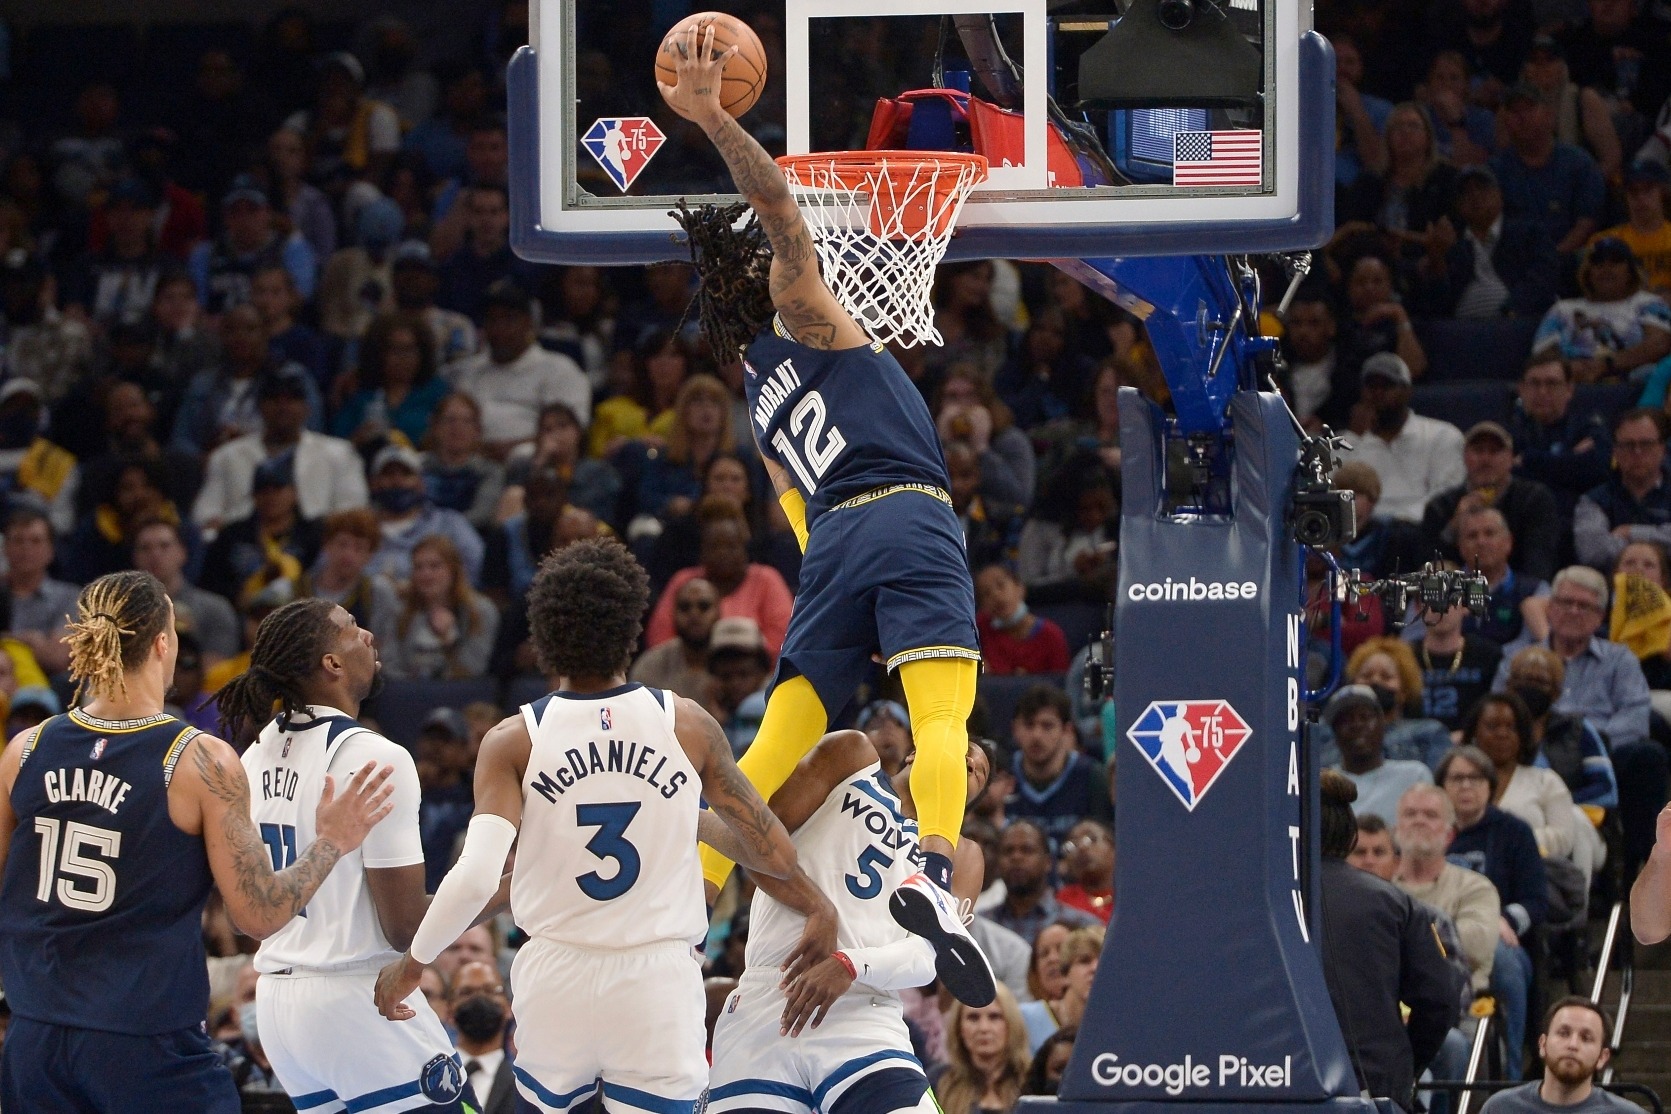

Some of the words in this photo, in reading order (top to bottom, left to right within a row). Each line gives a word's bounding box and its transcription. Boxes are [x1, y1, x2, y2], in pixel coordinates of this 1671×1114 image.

[631, 128, 647, 150] 75
[755, 358, 802, 432] MORANT
[771, 390, 847, 496] 12
[1128, 577, 1258, 602] coinbase
[1200, 716, 1224, 748] 75
[45, 767, 133, 815] CLARKE
[262, 766, 299, 802] REID
[531, 739, 688, 804] McDANIELS
[34, 816, 122, 912] 15
[575, 800, 642, 901] 3
[844, 843, 895, 900] 5
[1091, 1052, 1210, 1096] Google
[1218, 1054, 1291, 1087] Pixel
